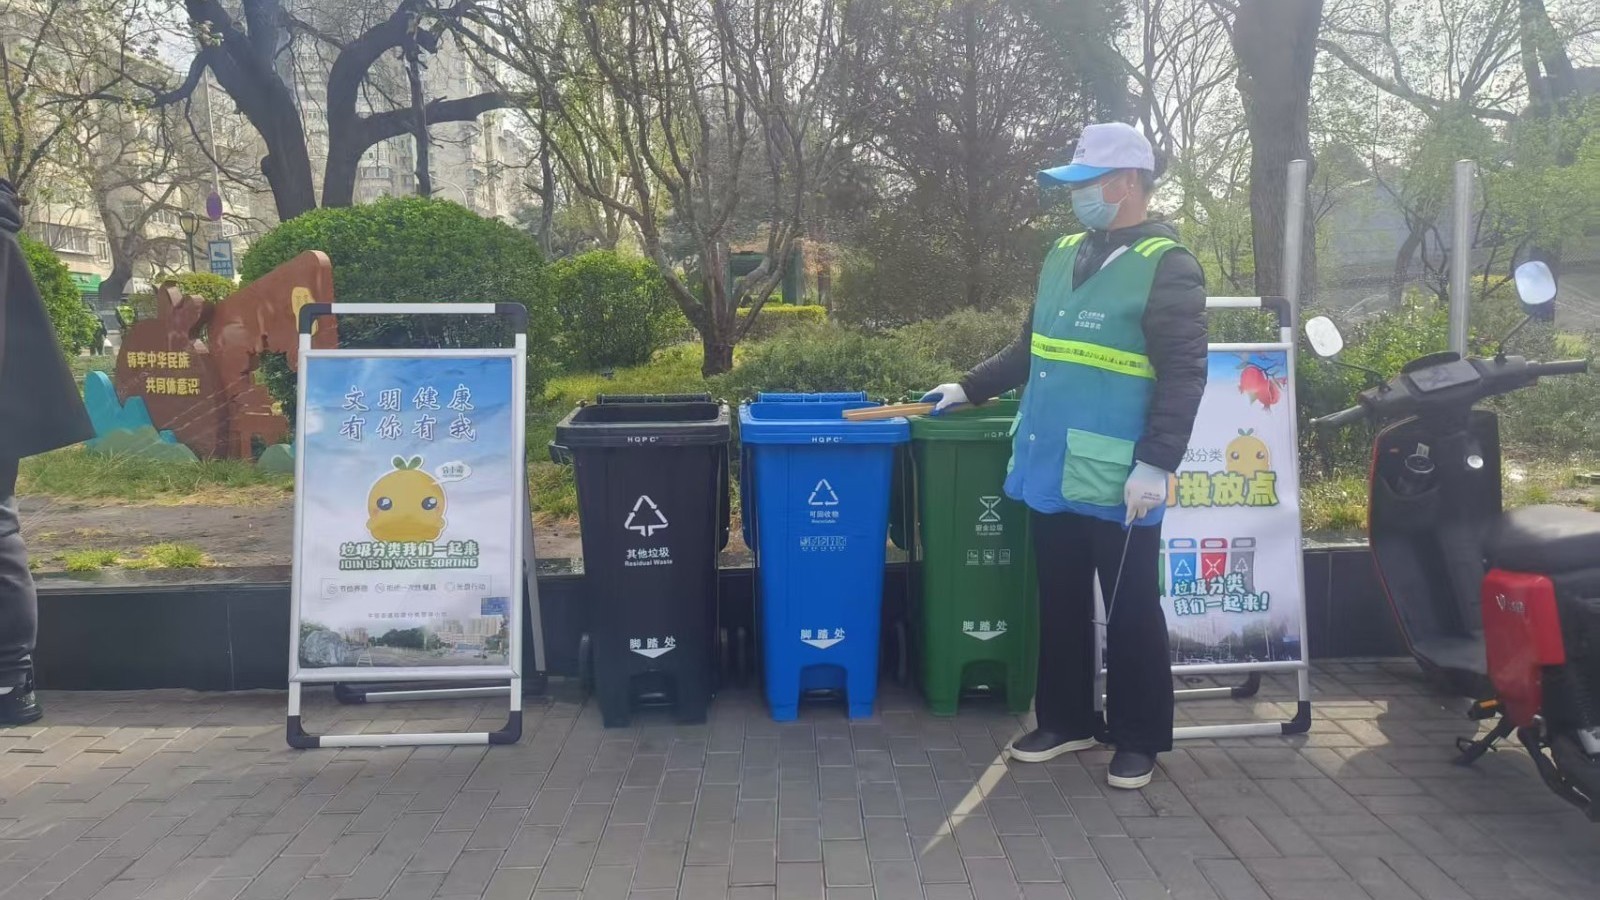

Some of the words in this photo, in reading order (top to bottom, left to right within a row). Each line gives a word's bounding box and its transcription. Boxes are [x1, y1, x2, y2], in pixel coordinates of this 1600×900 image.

[127, 351, 190, 368] 铸牢中华民族
[146, 377, 200, 395] 共同体意识
[341, 384, 475, 413] 文明健康
[339, 413, 477, 442] 有你有我
[339, 539, 480, 558] 垃圾分类我们一起来
[626, 547, 670, 559] 其他垃圾
[364, 557, 380, 569] US
[380, 557, 394, 569] IN
[394, 557, 429, 569] WASTE
[430, 556, 479, 568] SORTING
[1174, 572, 1246, 597] 垃圾分类
[800, 627, 846, 639] 脚踏处
[962, 620, 1008, 631] 脚踏处
[629, 635, 677, 649] 脚踏处
